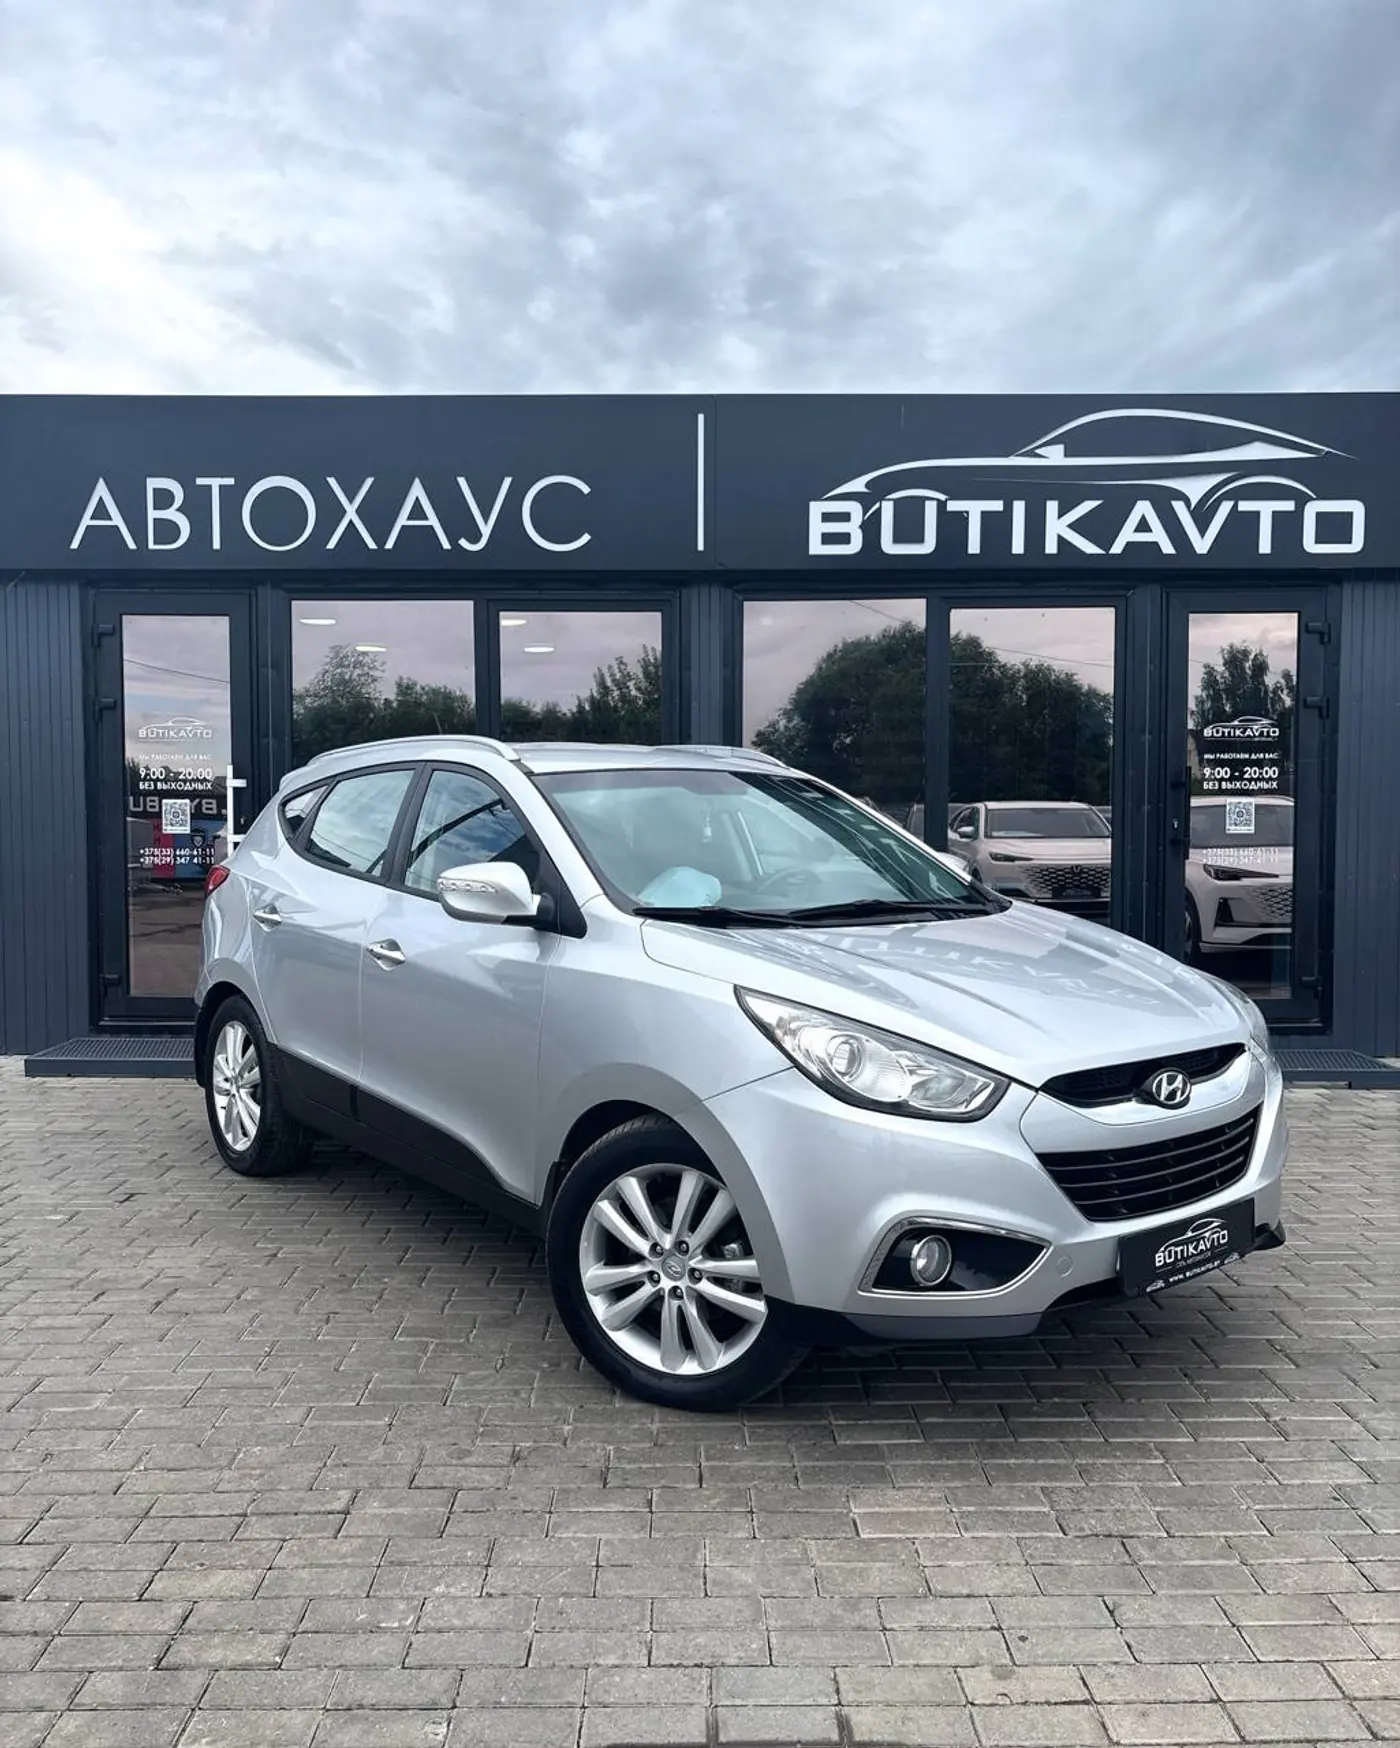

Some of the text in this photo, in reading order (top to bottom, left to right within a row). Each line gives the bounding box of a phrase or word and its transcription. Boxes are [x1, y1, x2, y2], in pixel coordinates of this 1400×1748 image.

[69, 474, 592, 552] АВТОХАУС
[807, 499, 1366, 556] BUTIKAVTO
[138, 729, 213, 738] BUTIKAVTO
[1203, 728, 1280, 737] BUTIKAVTO
[139, 767, 165, 779] 9:00
[1203, 767, 1231, 779] 9:00
[1243, 767, 1279, 779] 20:00
[139, 781, 212, 790] БЕЗ ВЫХОДНЫХ
[1203, 781, 1279, 790] БЕЗ ВЫХОДНЫХ
[1154, 1230, 1228, 1267] BUTIKAVTO
